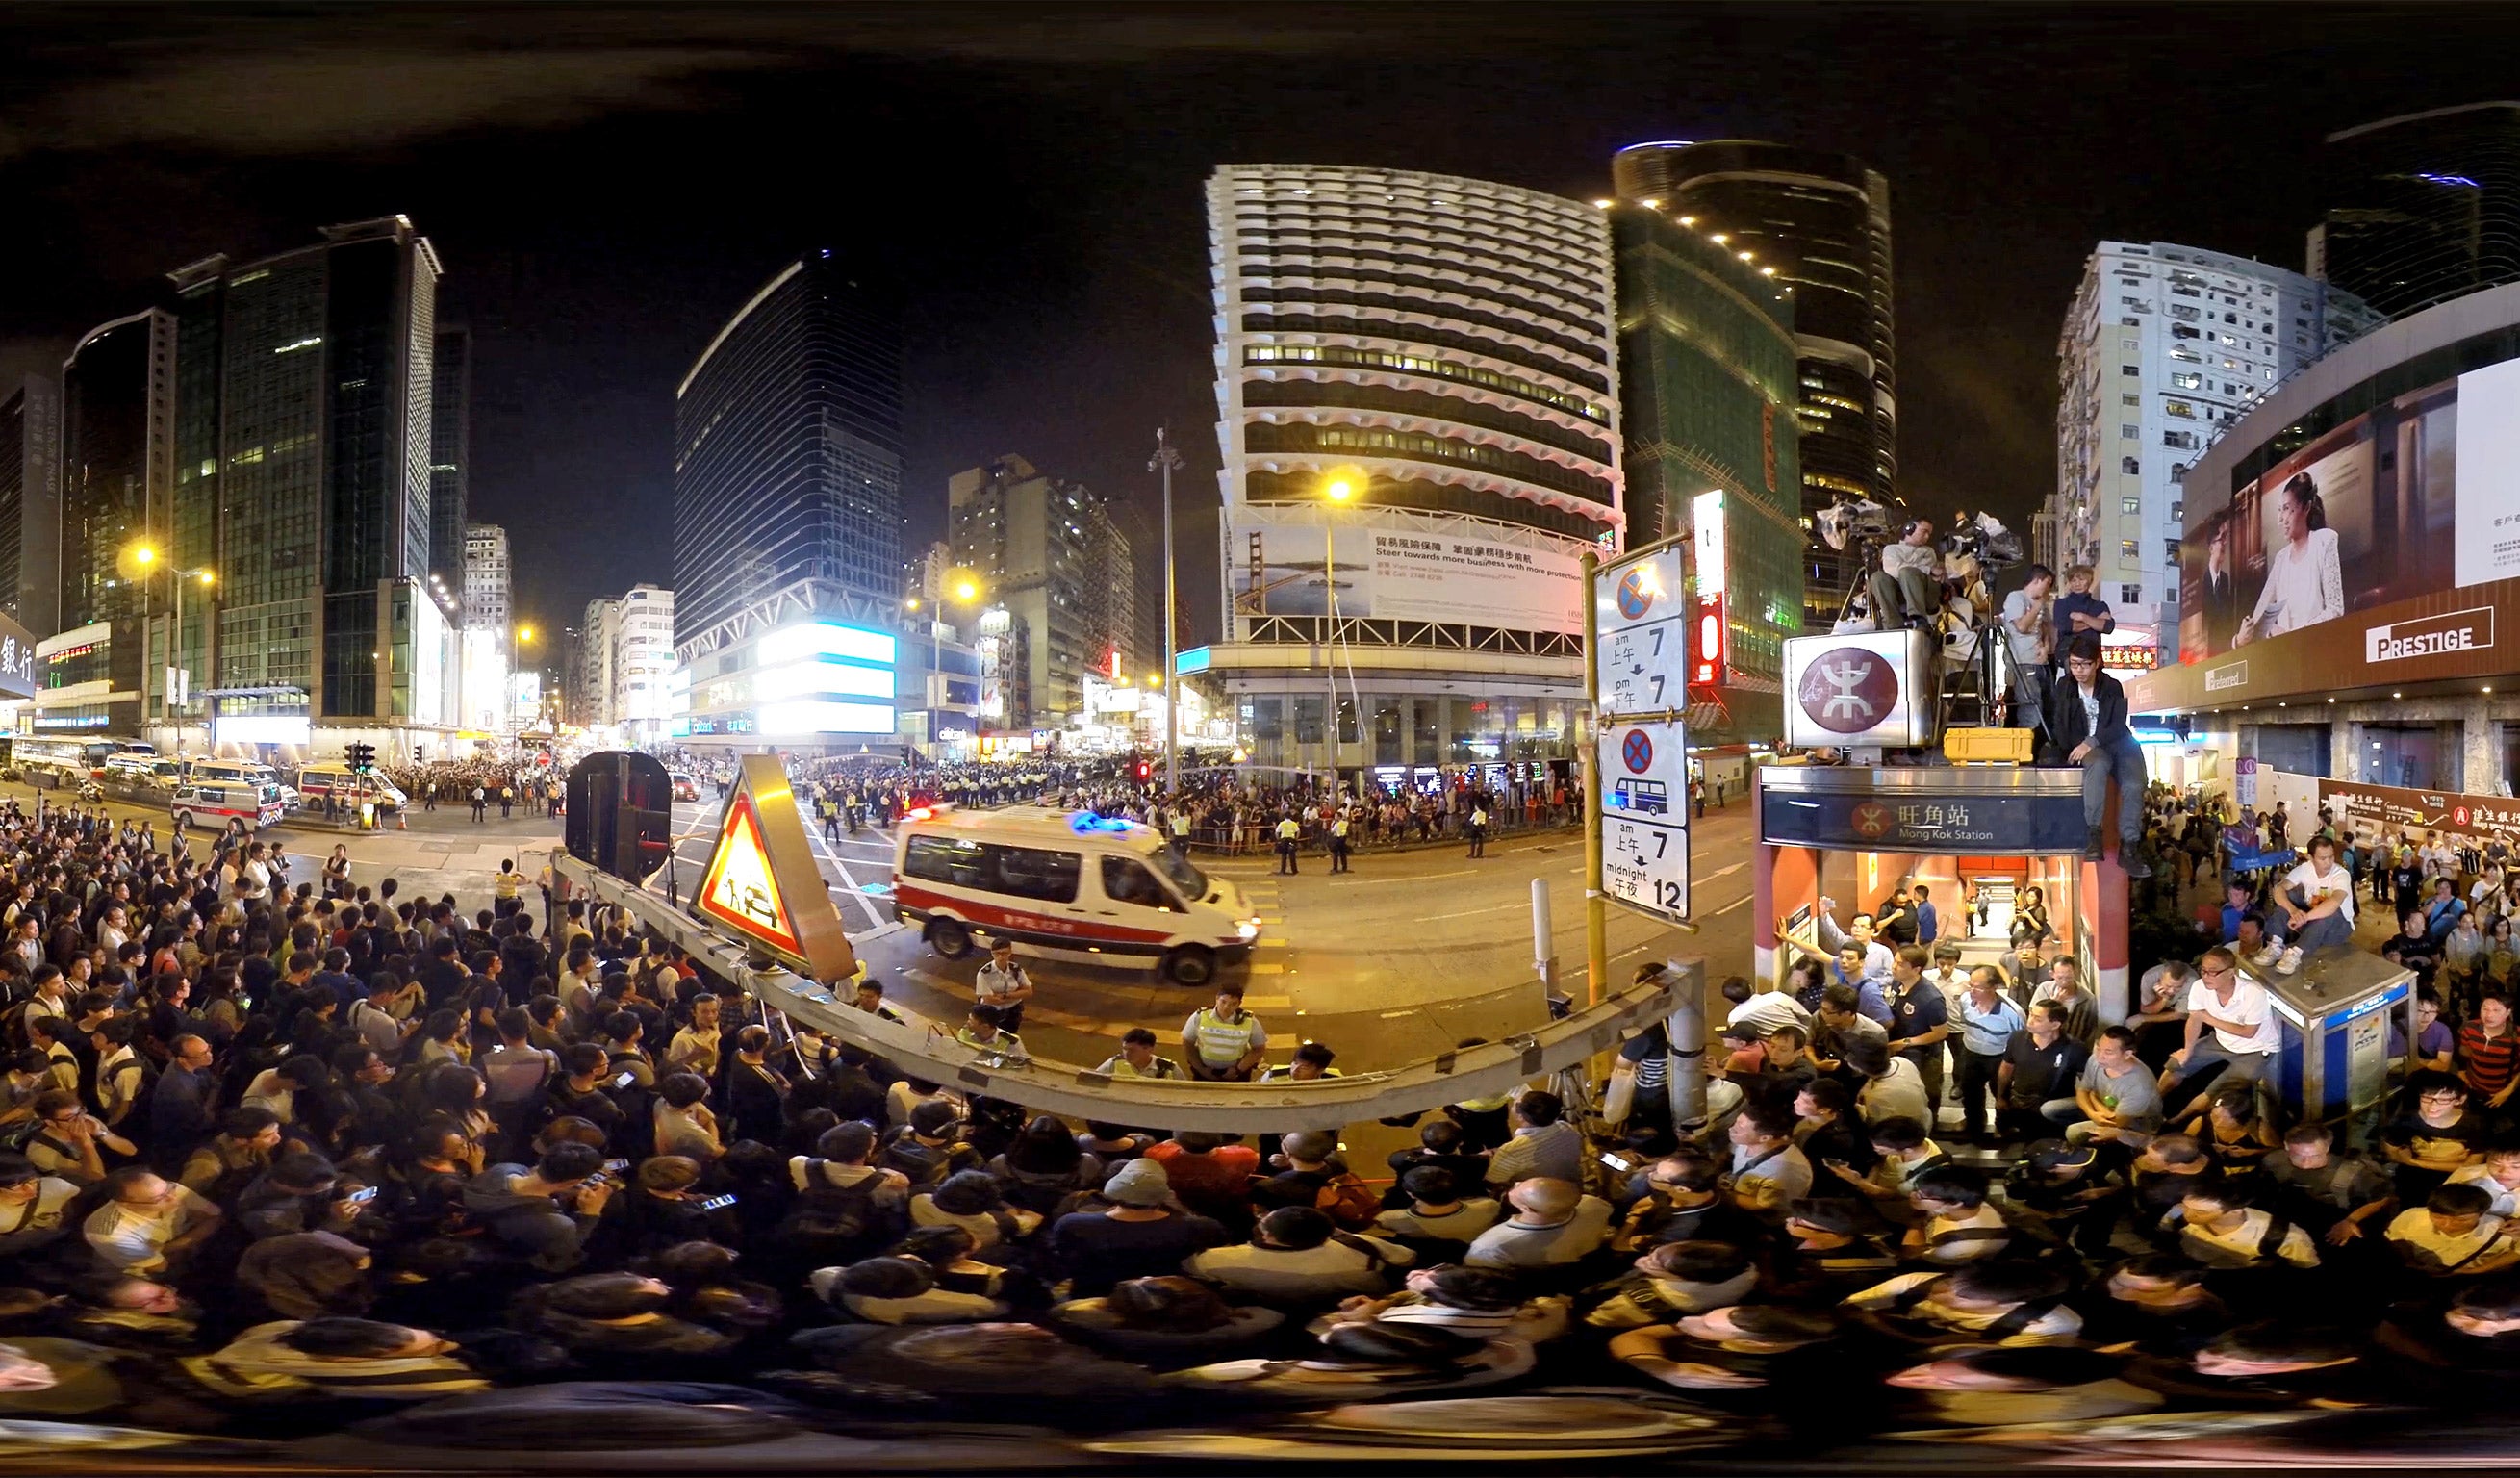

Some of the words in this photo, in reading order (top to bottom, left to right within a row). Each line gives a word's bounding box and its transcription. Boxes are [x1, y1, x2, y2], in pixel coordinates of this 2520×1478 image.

[1376, 548, 1401, 557] Steer
[1404, 550, 1440, 561] towards
[1442, 555, 1465, 564] more
[1467, 557, 1505, 568] business
[1507, 562, 1525, 571] with
[1526, 566, 1545, 574] more
[1546, 570, 1582, 581] protection
[1615, 635, 1629, 646] am
[1649, 627, 1665, 657] 7
[2378, 627, 2473, 659] PRESTIGE
[1, 634, 33, 682] 銀行
[1611, 648, 1635, 666] 上午
[1616, 678, 1630, 691] pm
[1650, 675, 1666, 704] 7
[1613, 692, 1636, 708] 下午
[1898, 804, 1969, 827] 旺角站
[1620, 823, 1634, 834] am
[1899, 828, 1930, 841] Mong
[1932, 828, 1952, 840] Kok
[1955, 829, 1994, 840] Station
[1616, 837, 1640, 854] 上午
[1652, 831, 1667, 859] 7
[1606, 863, 1647, 882] midnight
[1615, 878, 1638, 898] 午夜
[1654, 879, 1681, 910] 12
